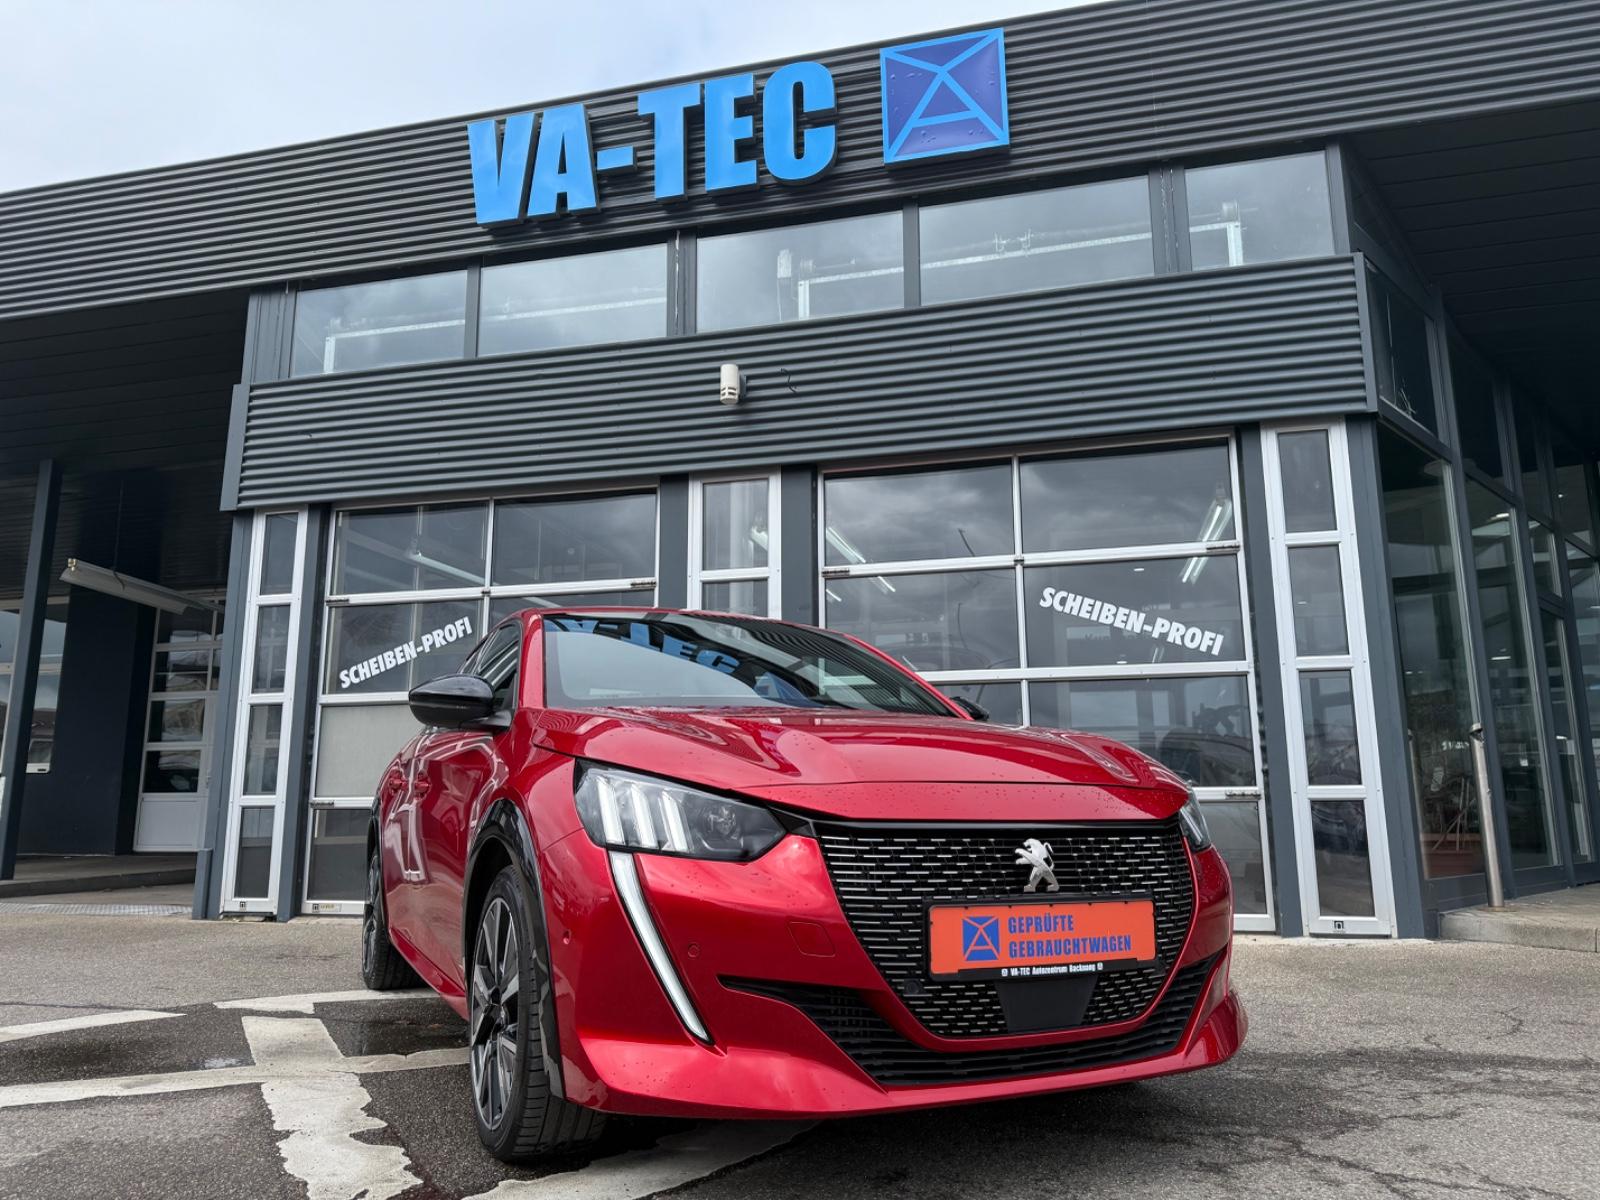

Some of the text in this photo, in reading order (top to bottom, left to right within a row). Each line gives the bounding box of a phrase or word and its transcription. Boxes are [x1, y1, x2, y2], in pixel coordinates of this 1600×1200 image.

[467, 61, 837, 226] VA-TEC
[1039, 587, 1224, 656] SCHEIBEN-PROFI
[339, 616, 473, 689] SCHEIBEN-PROFI
[1008, 912, 1074, 934] GEPRÜFTE
[1009, 934, 1132, 959] GEBRAUCHTWAGEN
[1010, 967, 1031, 977] VA-TEC
[1031, 965, 1068, 976] Autozentrum
